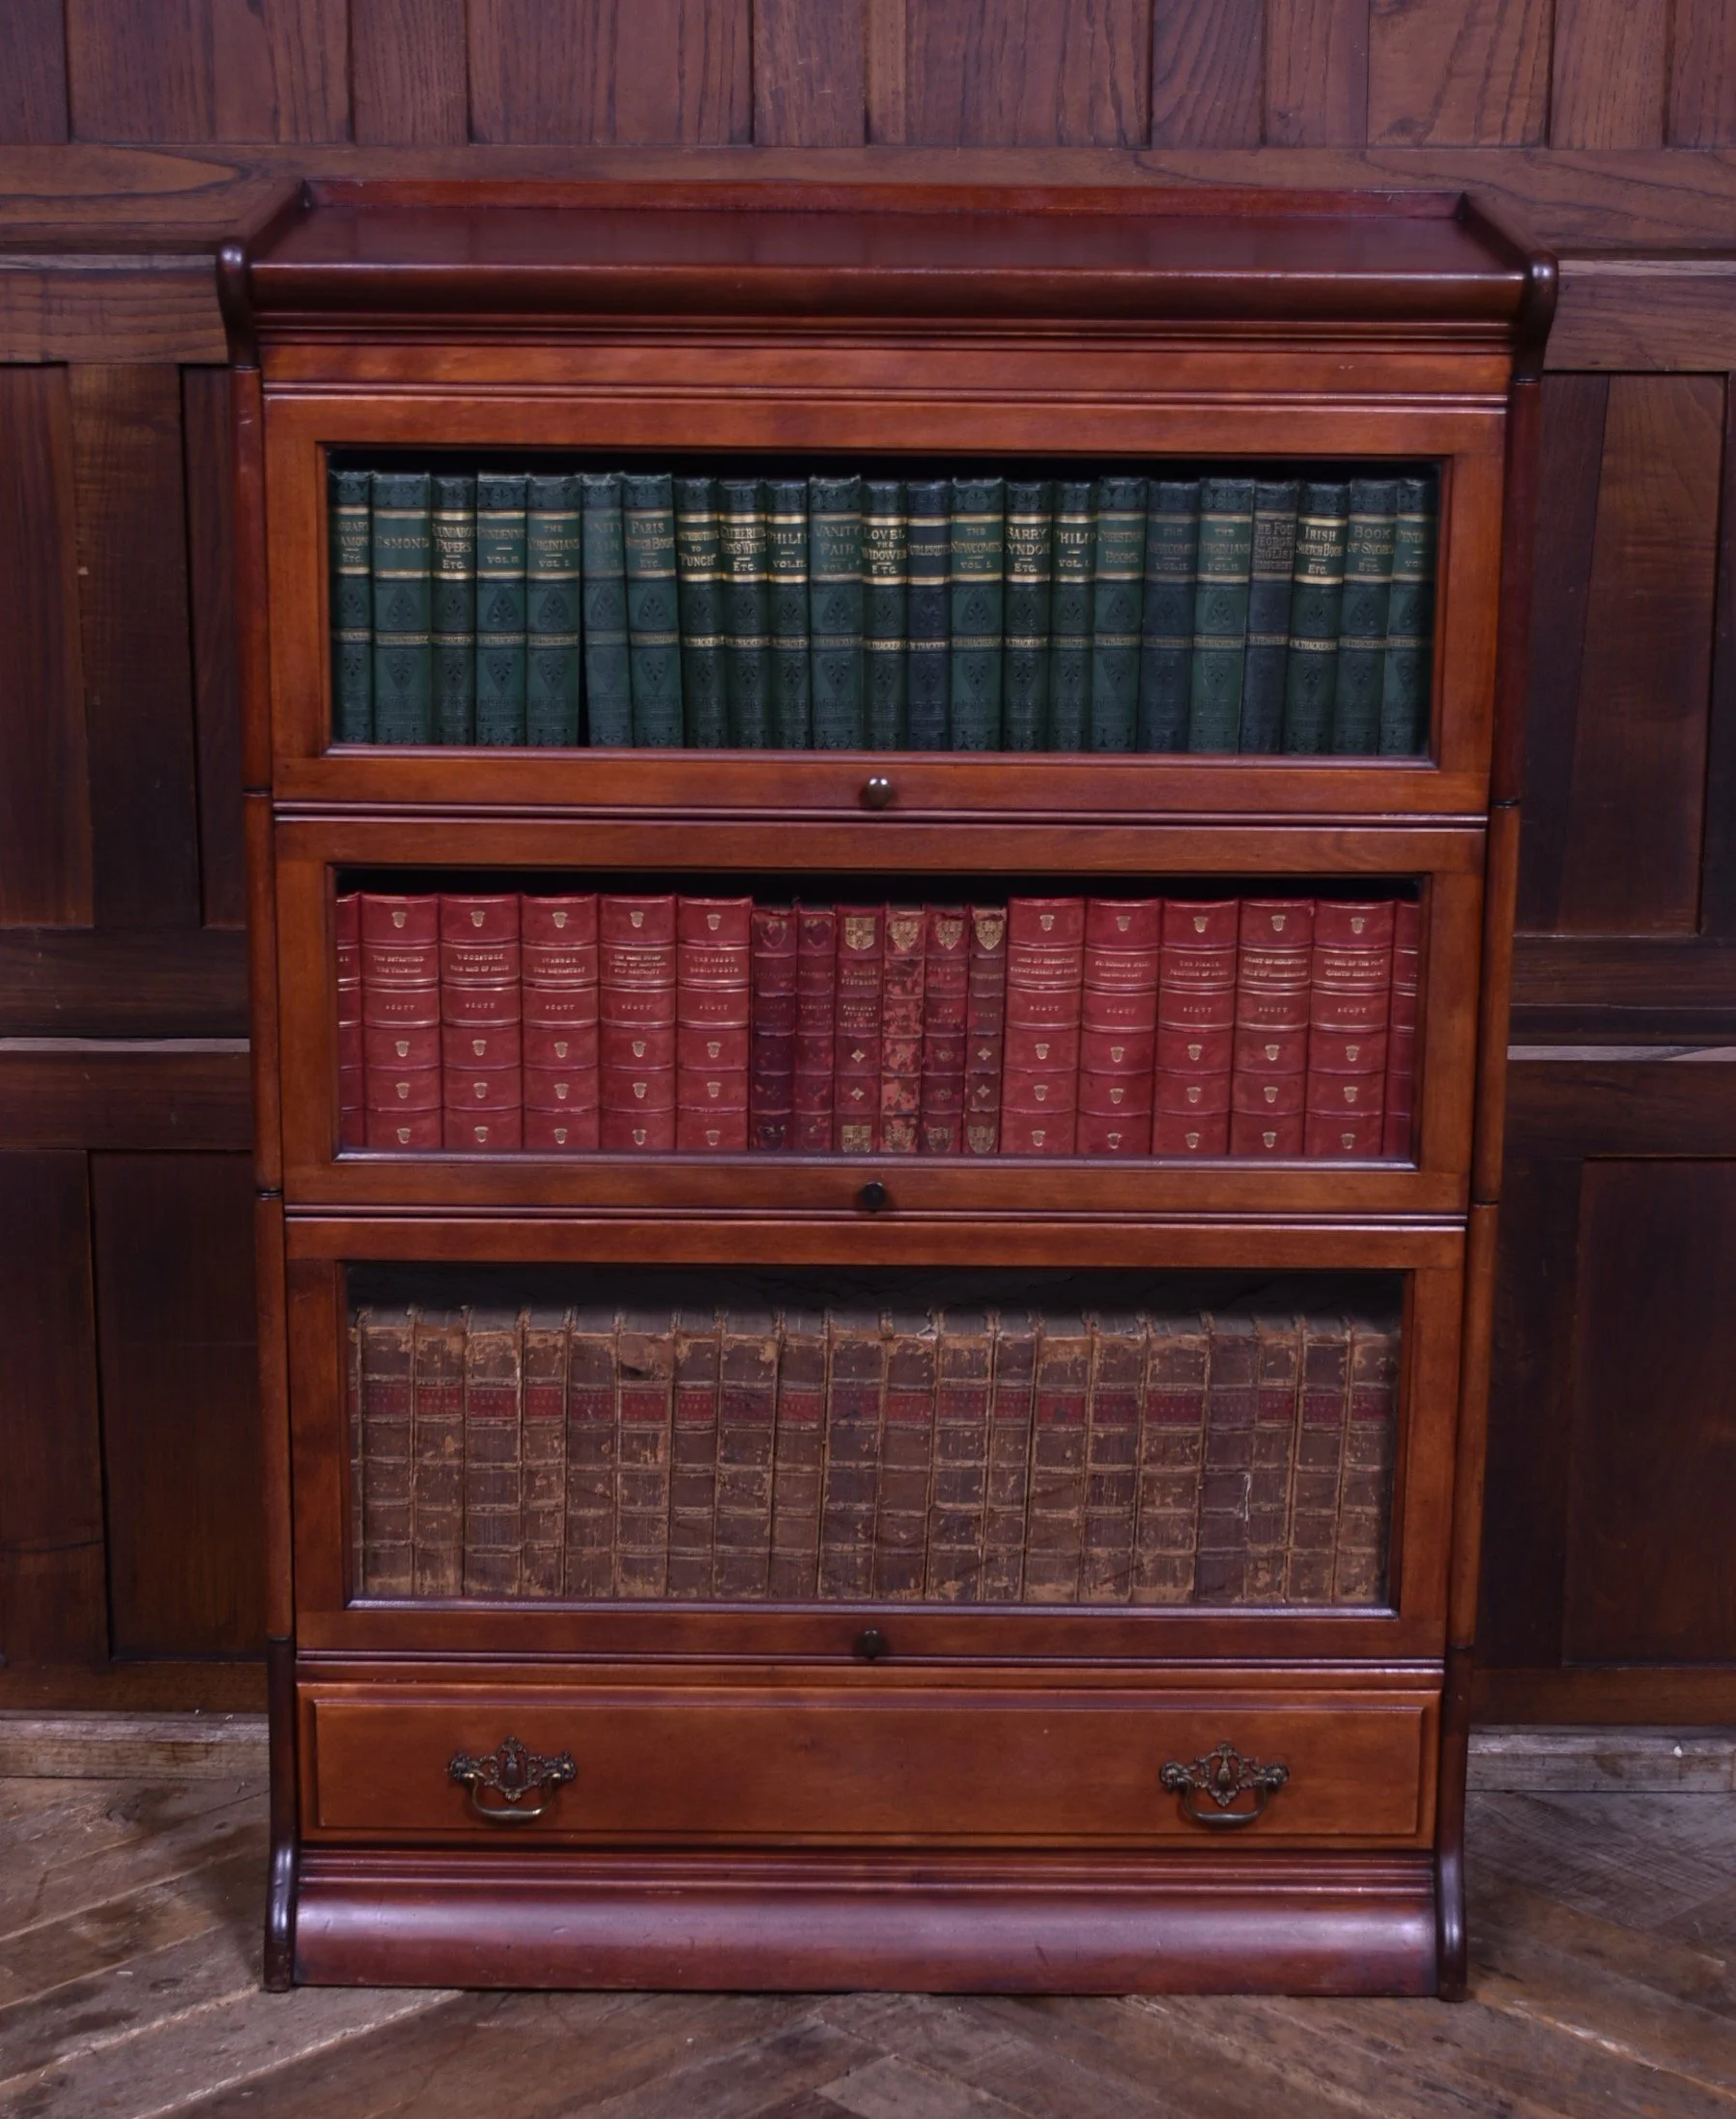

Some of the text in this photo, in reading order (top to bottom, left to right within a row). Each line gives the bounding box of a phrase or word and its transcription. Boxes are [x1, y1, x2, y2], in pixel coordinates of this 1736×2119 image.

[631, 520, 666, 534] PARIS
[816, 524, 860, 537] VANITY
[863, 529, 905, 539] LOVEL
[1305, 526, 1337, 542] IRISH
[1353, 525, 1391, 539] BOOK
[375, 535, 430, 549] ESMOND
[435, 539, 472, 553] PAPERS
[690, 544, 703, 553] TO
[819, 542, 855, 556] FAIR
[1104, 551, 1139, 563] BOOKS
